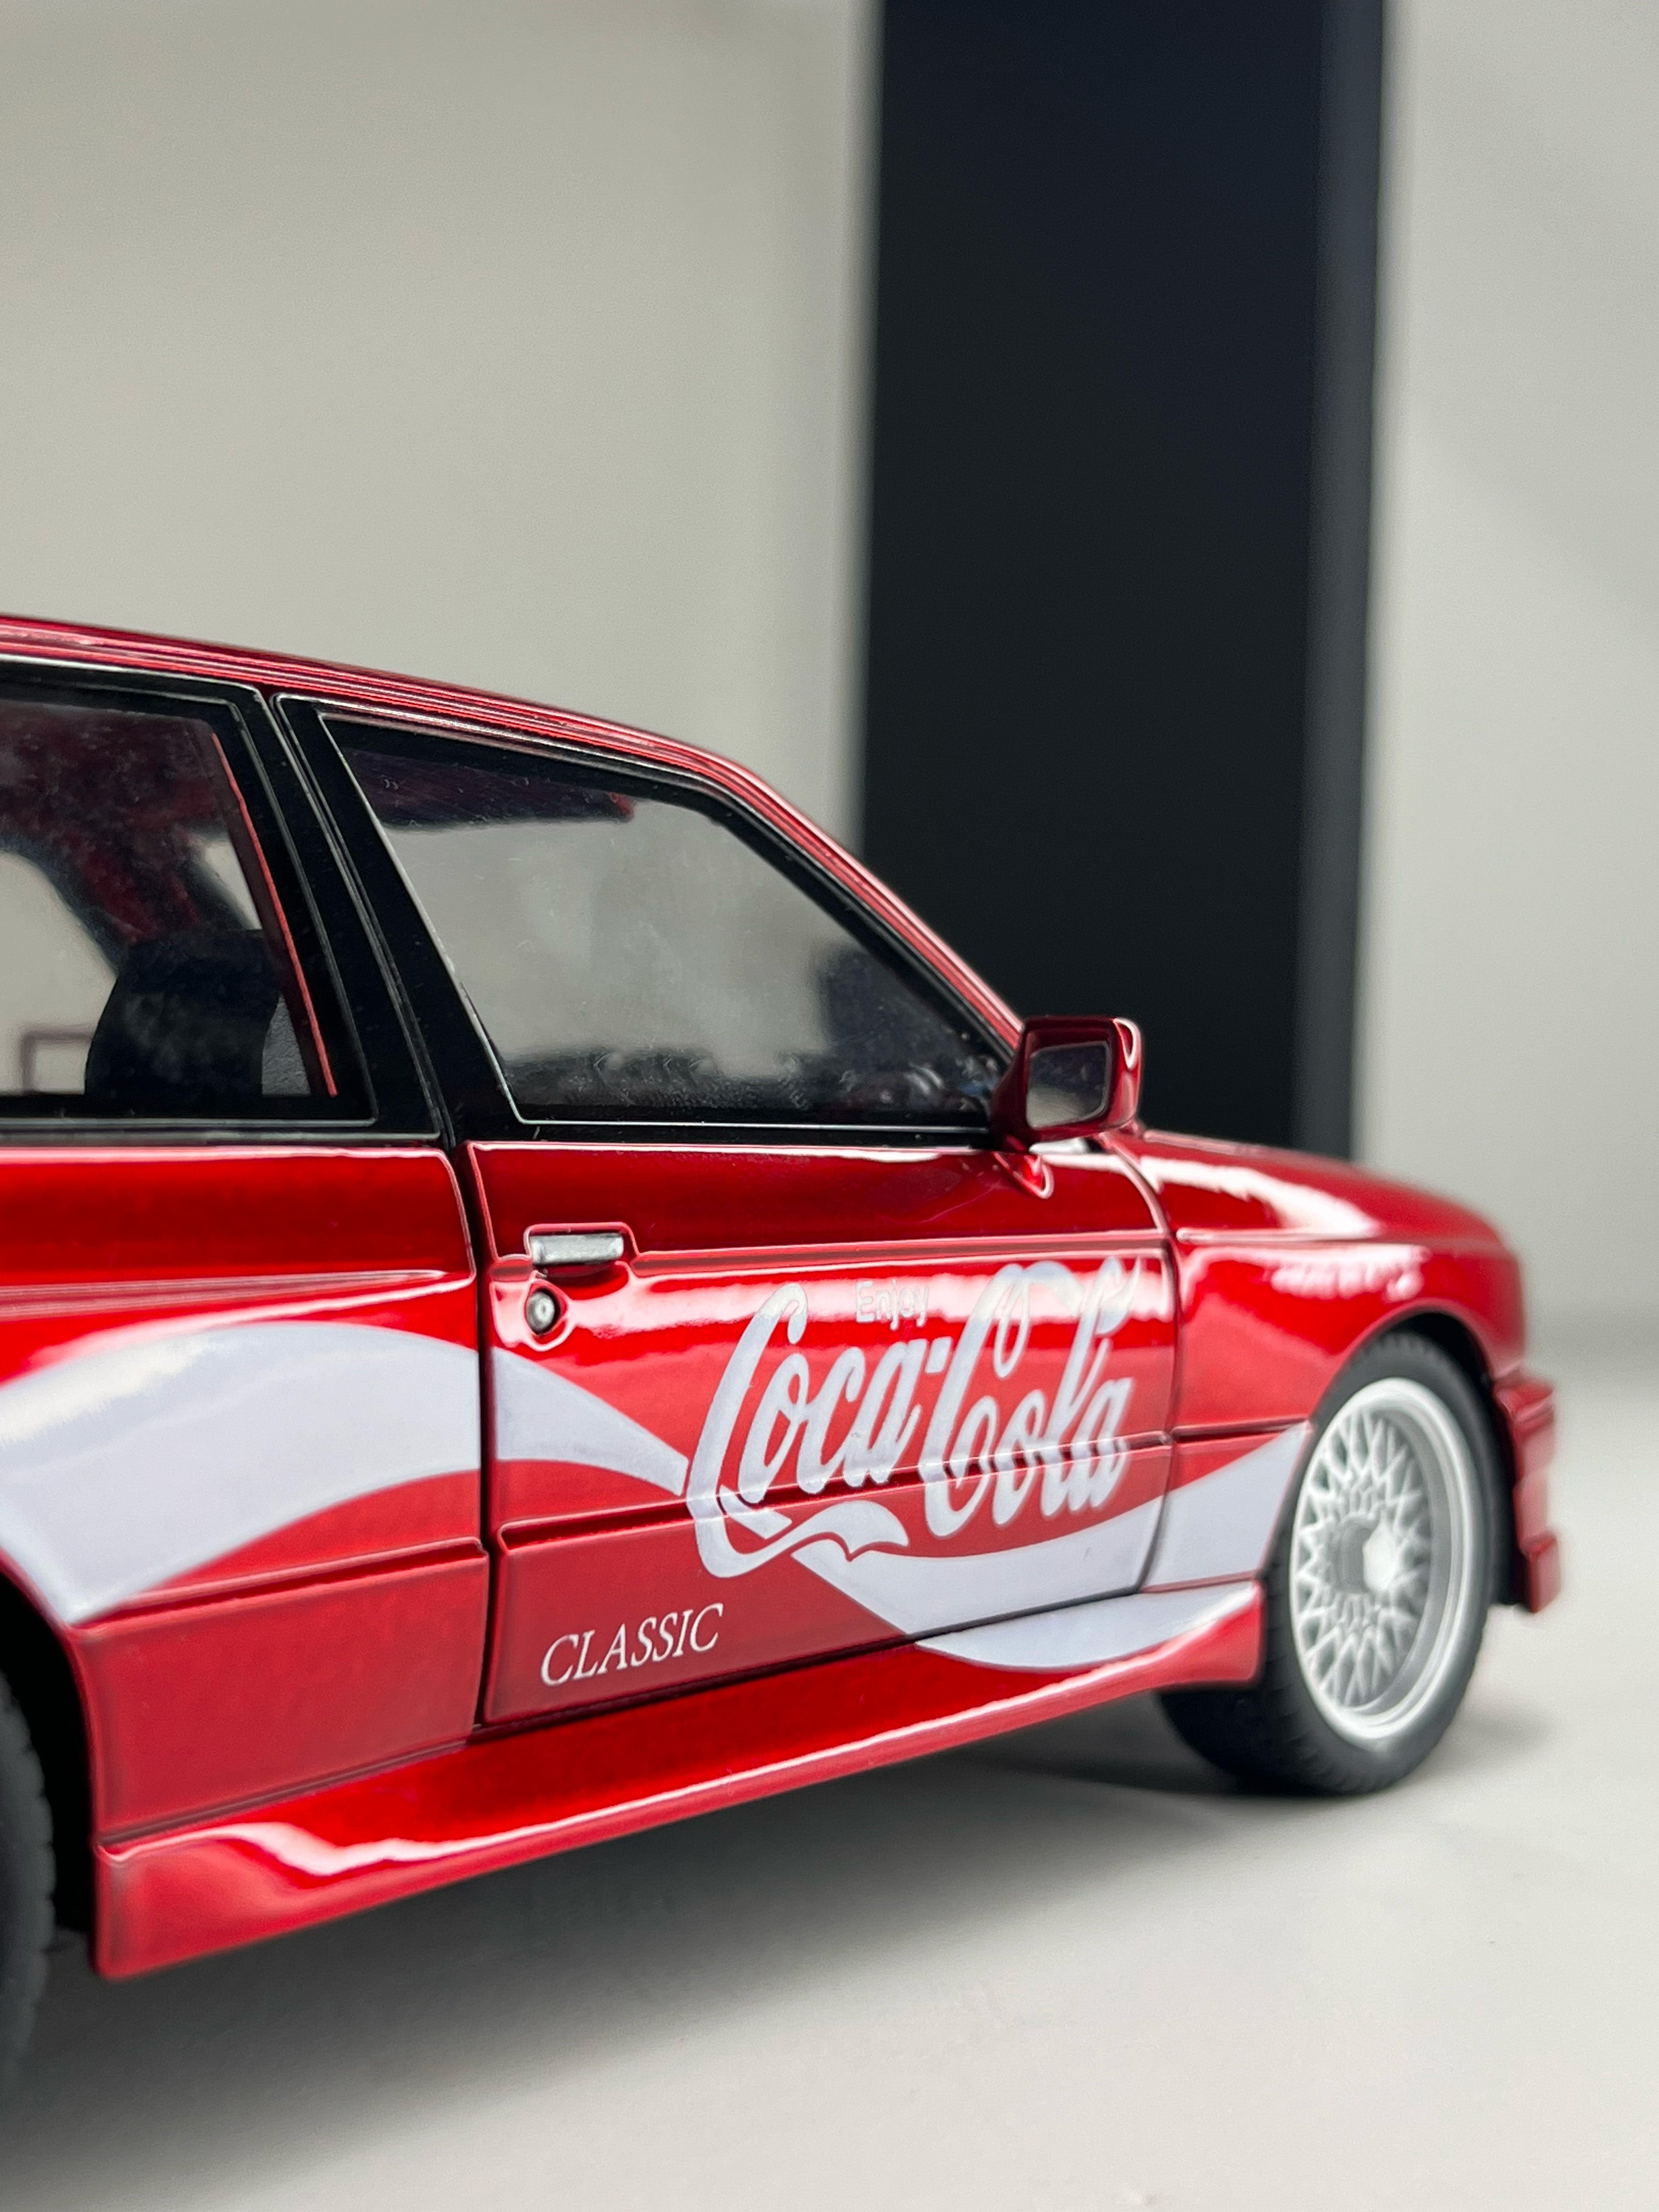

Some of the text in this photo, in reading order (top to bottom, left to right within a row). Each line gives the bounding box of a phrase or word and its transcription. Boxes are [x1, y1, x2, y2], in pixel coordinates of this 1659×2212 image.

[856, 1279, 930, 1331] Enjoy
[686, 1256, 1141, 1577] Coca-Cola
[540, 1602, 724, 1685] CLASSIC
